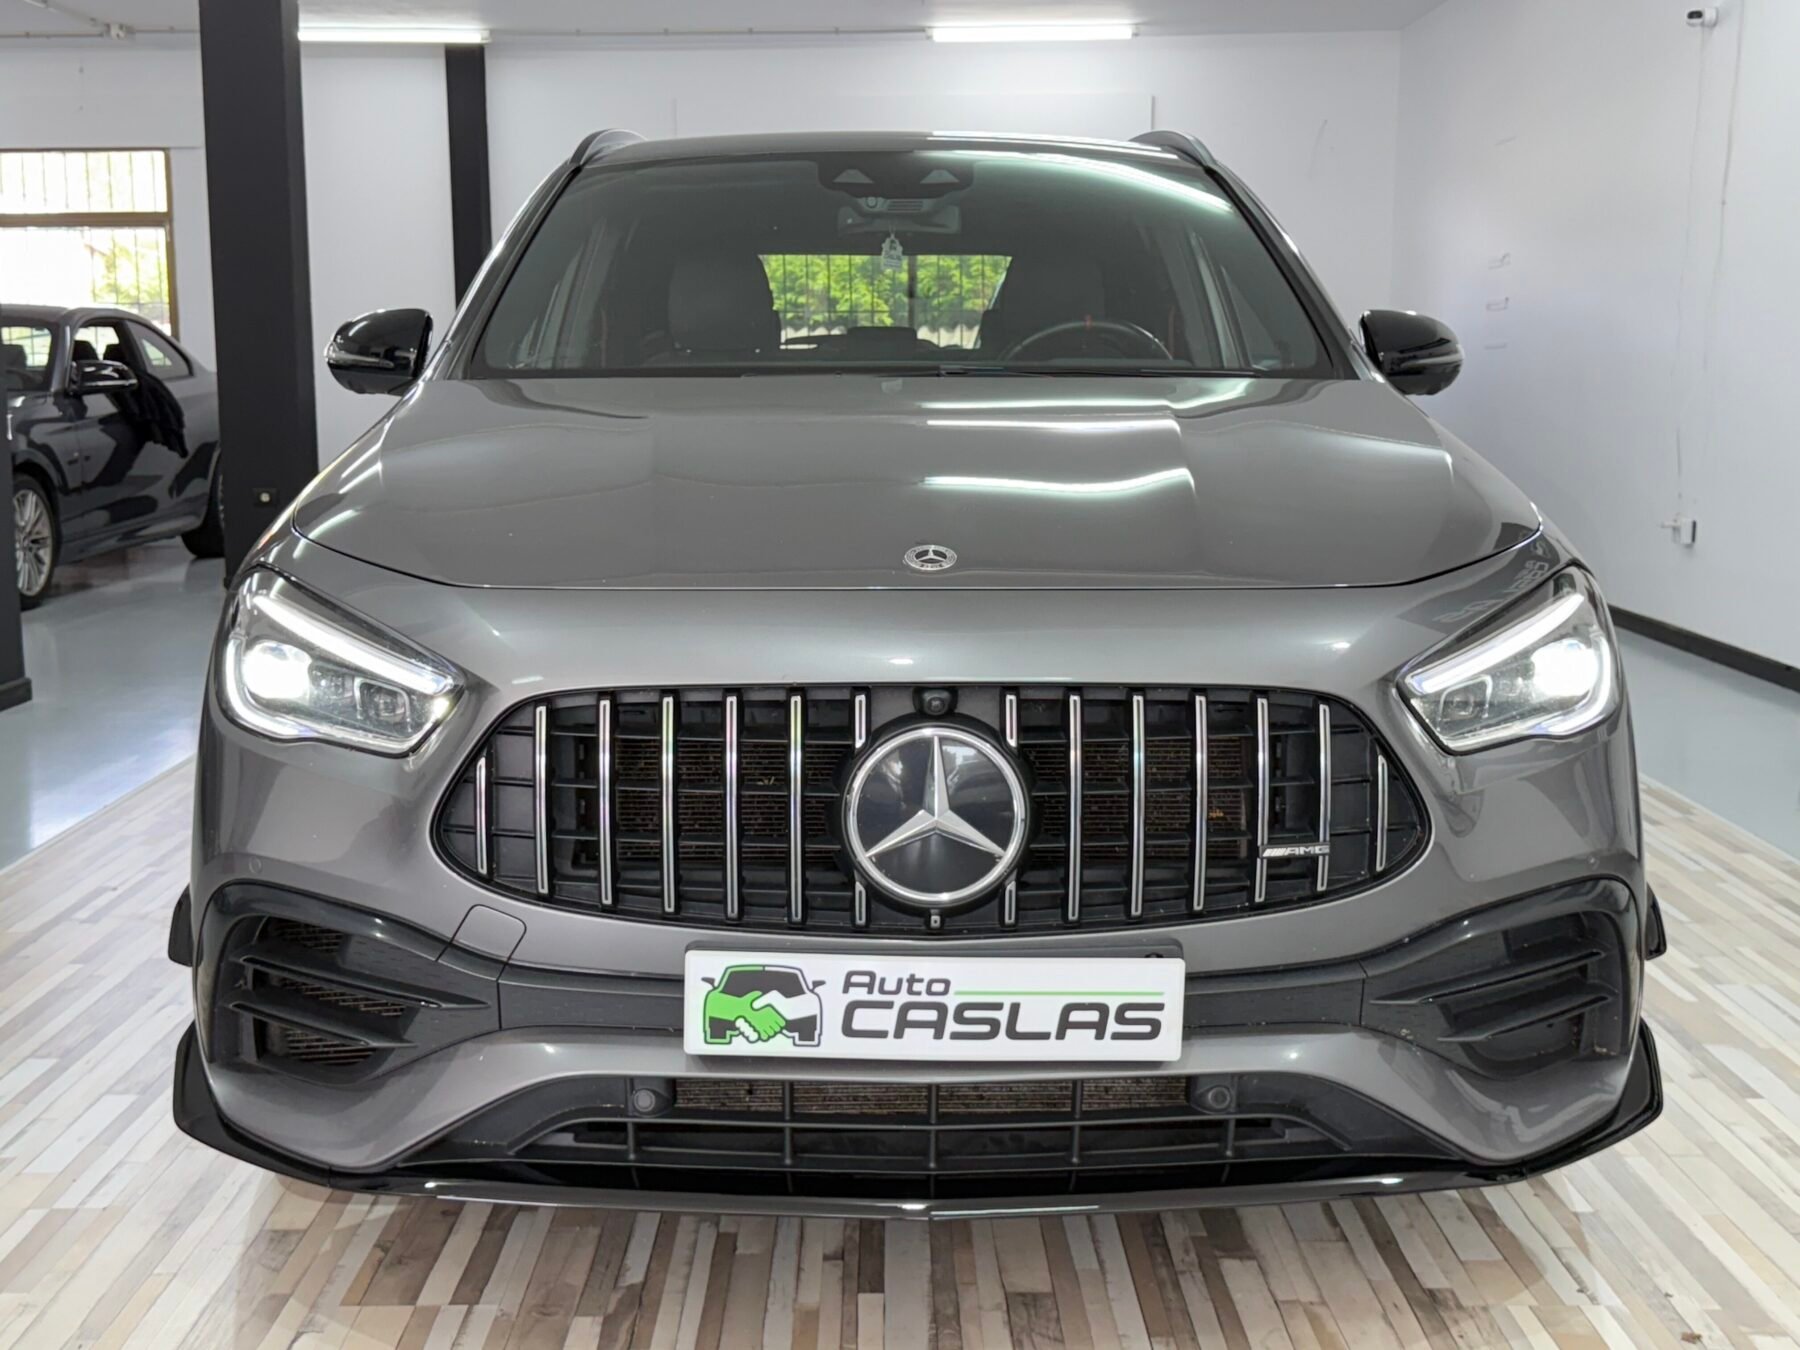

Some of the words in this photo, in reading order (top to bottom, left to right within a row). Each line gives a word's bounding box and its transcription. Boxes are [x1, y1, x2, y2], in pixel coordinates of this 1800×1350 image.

[1285, 845, 1330, 856] AMG
[842, 970, 951, 996] Auto
[841, 1001, 1165, 1041] CASLAS
